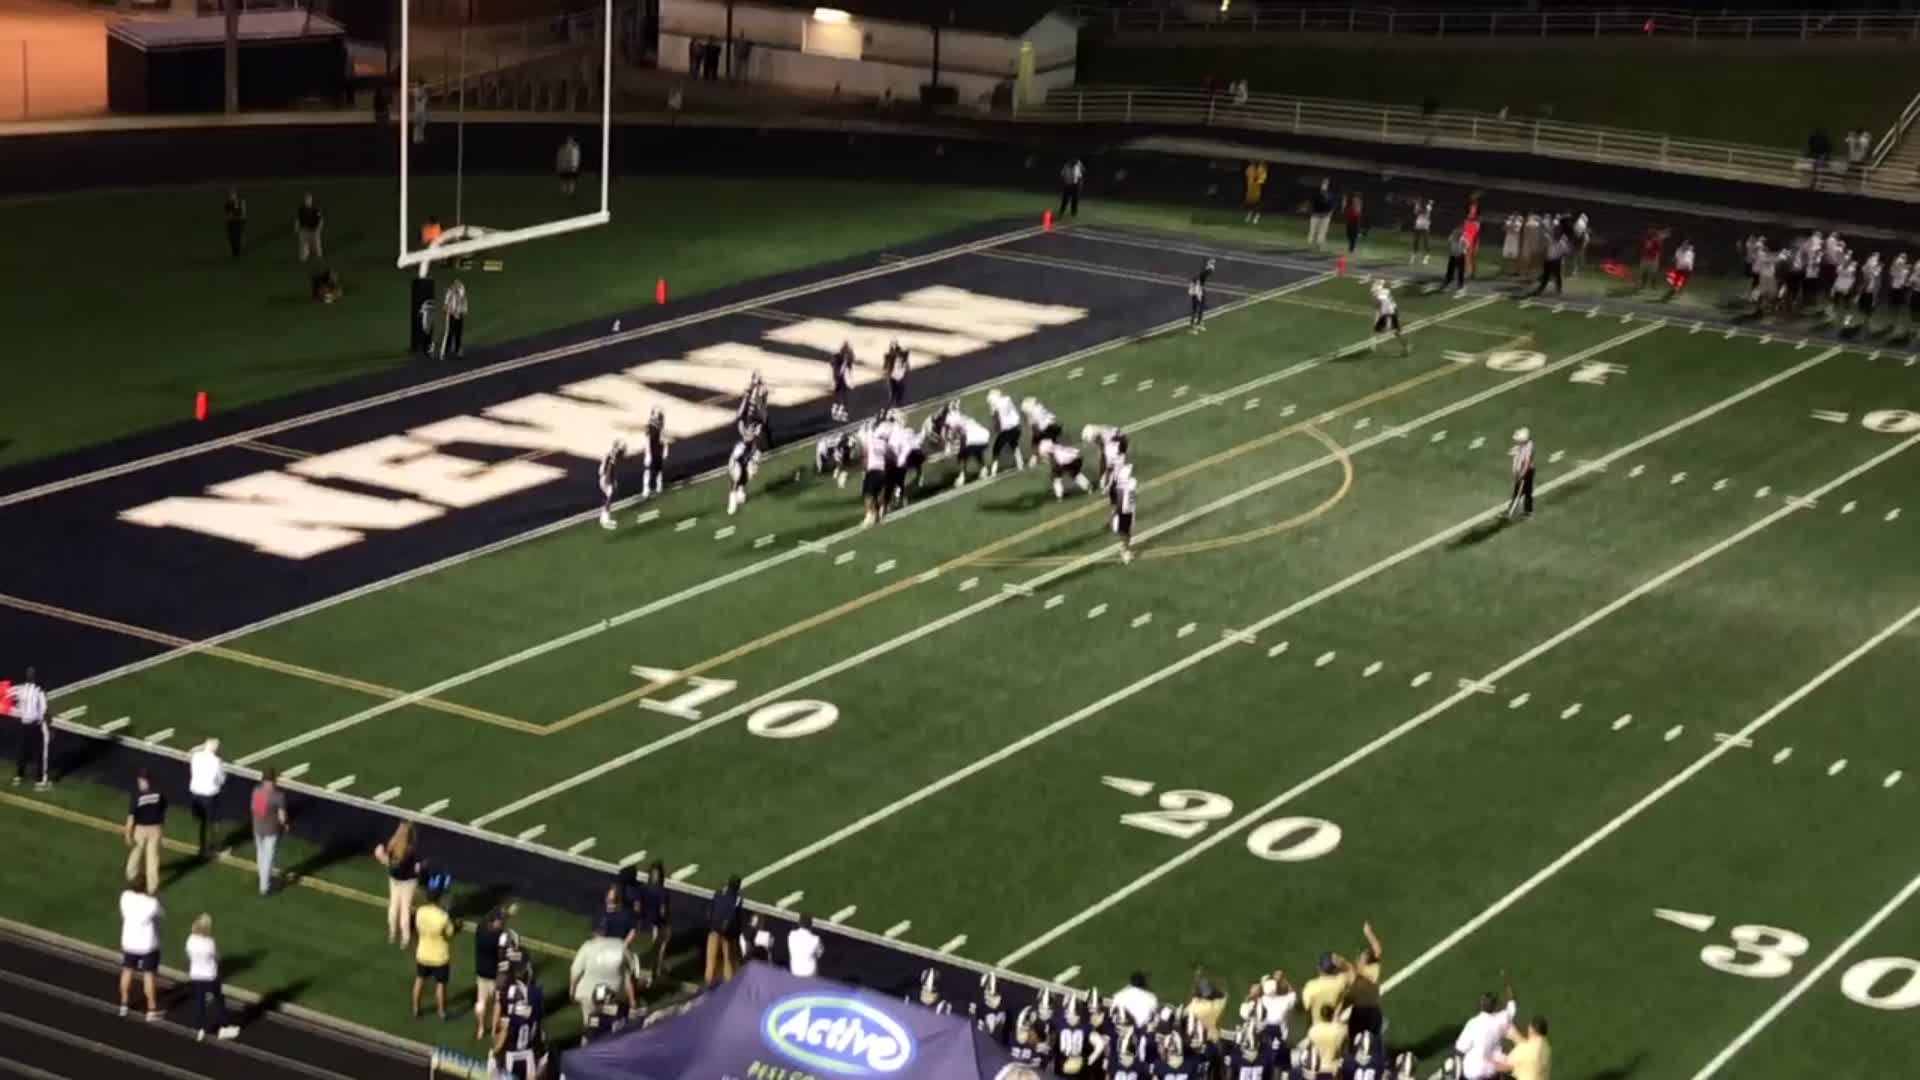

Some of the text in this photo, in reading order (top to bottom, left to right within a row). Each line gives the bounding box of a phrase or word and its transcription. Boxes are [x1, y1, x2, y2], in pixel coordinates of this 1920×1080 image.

[638, 679, 839, 738] 10
[1120, 789, 1342, 861] 20
[1701, 924, 1920, 1010] 30
[779, 1006, 905, 1071] Active
